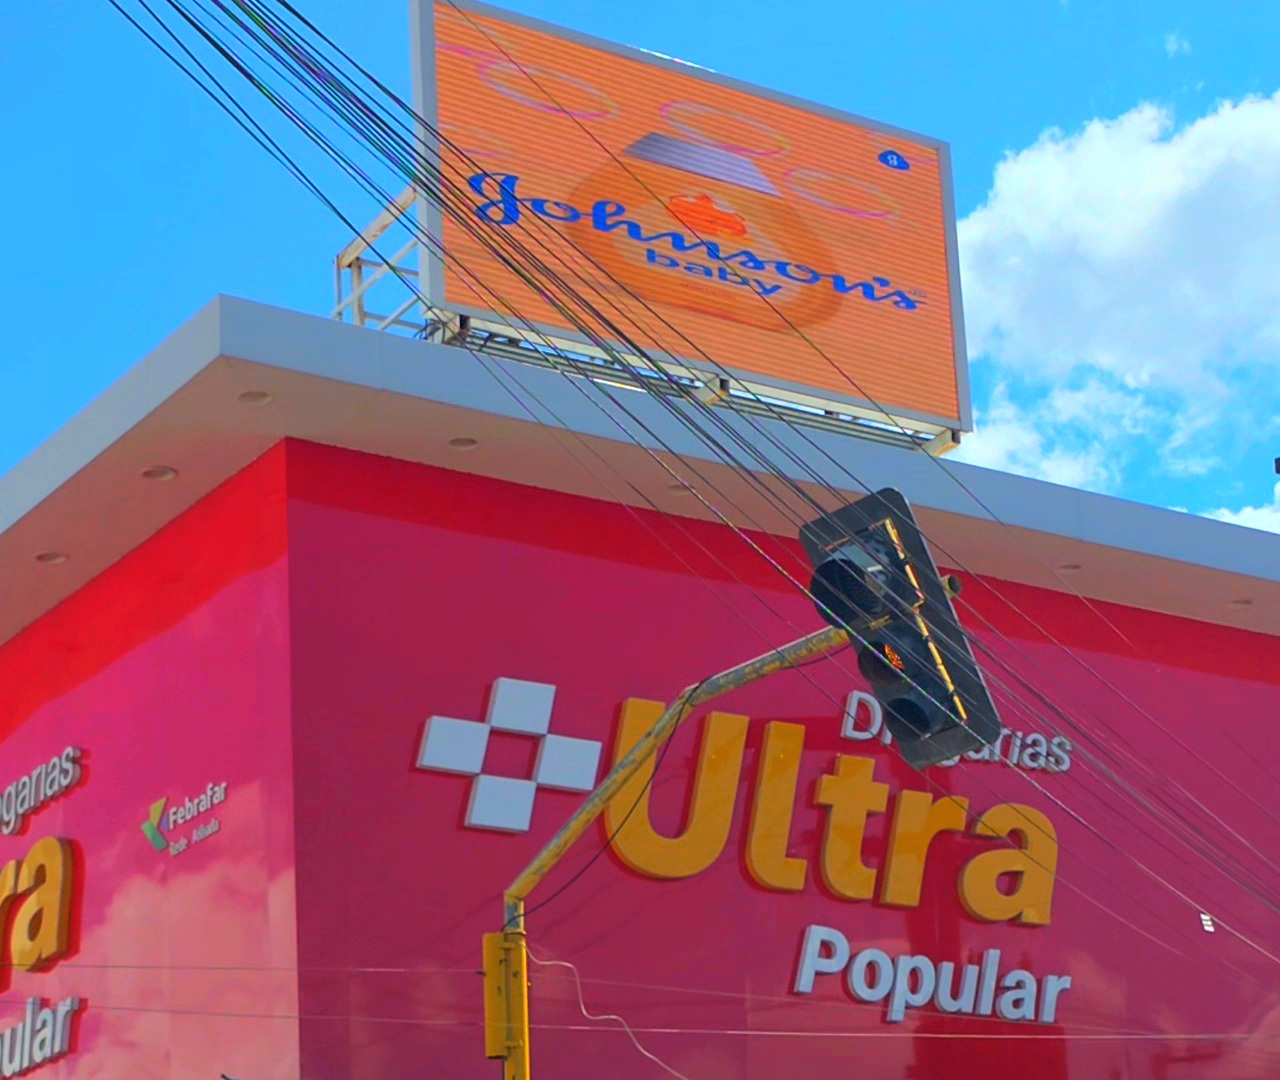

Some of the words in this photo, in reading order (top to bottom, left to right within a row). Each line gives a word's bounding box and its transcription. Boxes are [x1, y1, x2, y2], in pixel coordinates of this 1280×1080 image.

[467, 172, 923, 312] Johnson's
[645, 247, 783, 297] baby
[839, 690, 1073, 772] Darias
[168, 782, 227, 830] Febrafar
[602, 697, 1060, 926] Ultra
[794, 925, 1072, 1024] Popular
